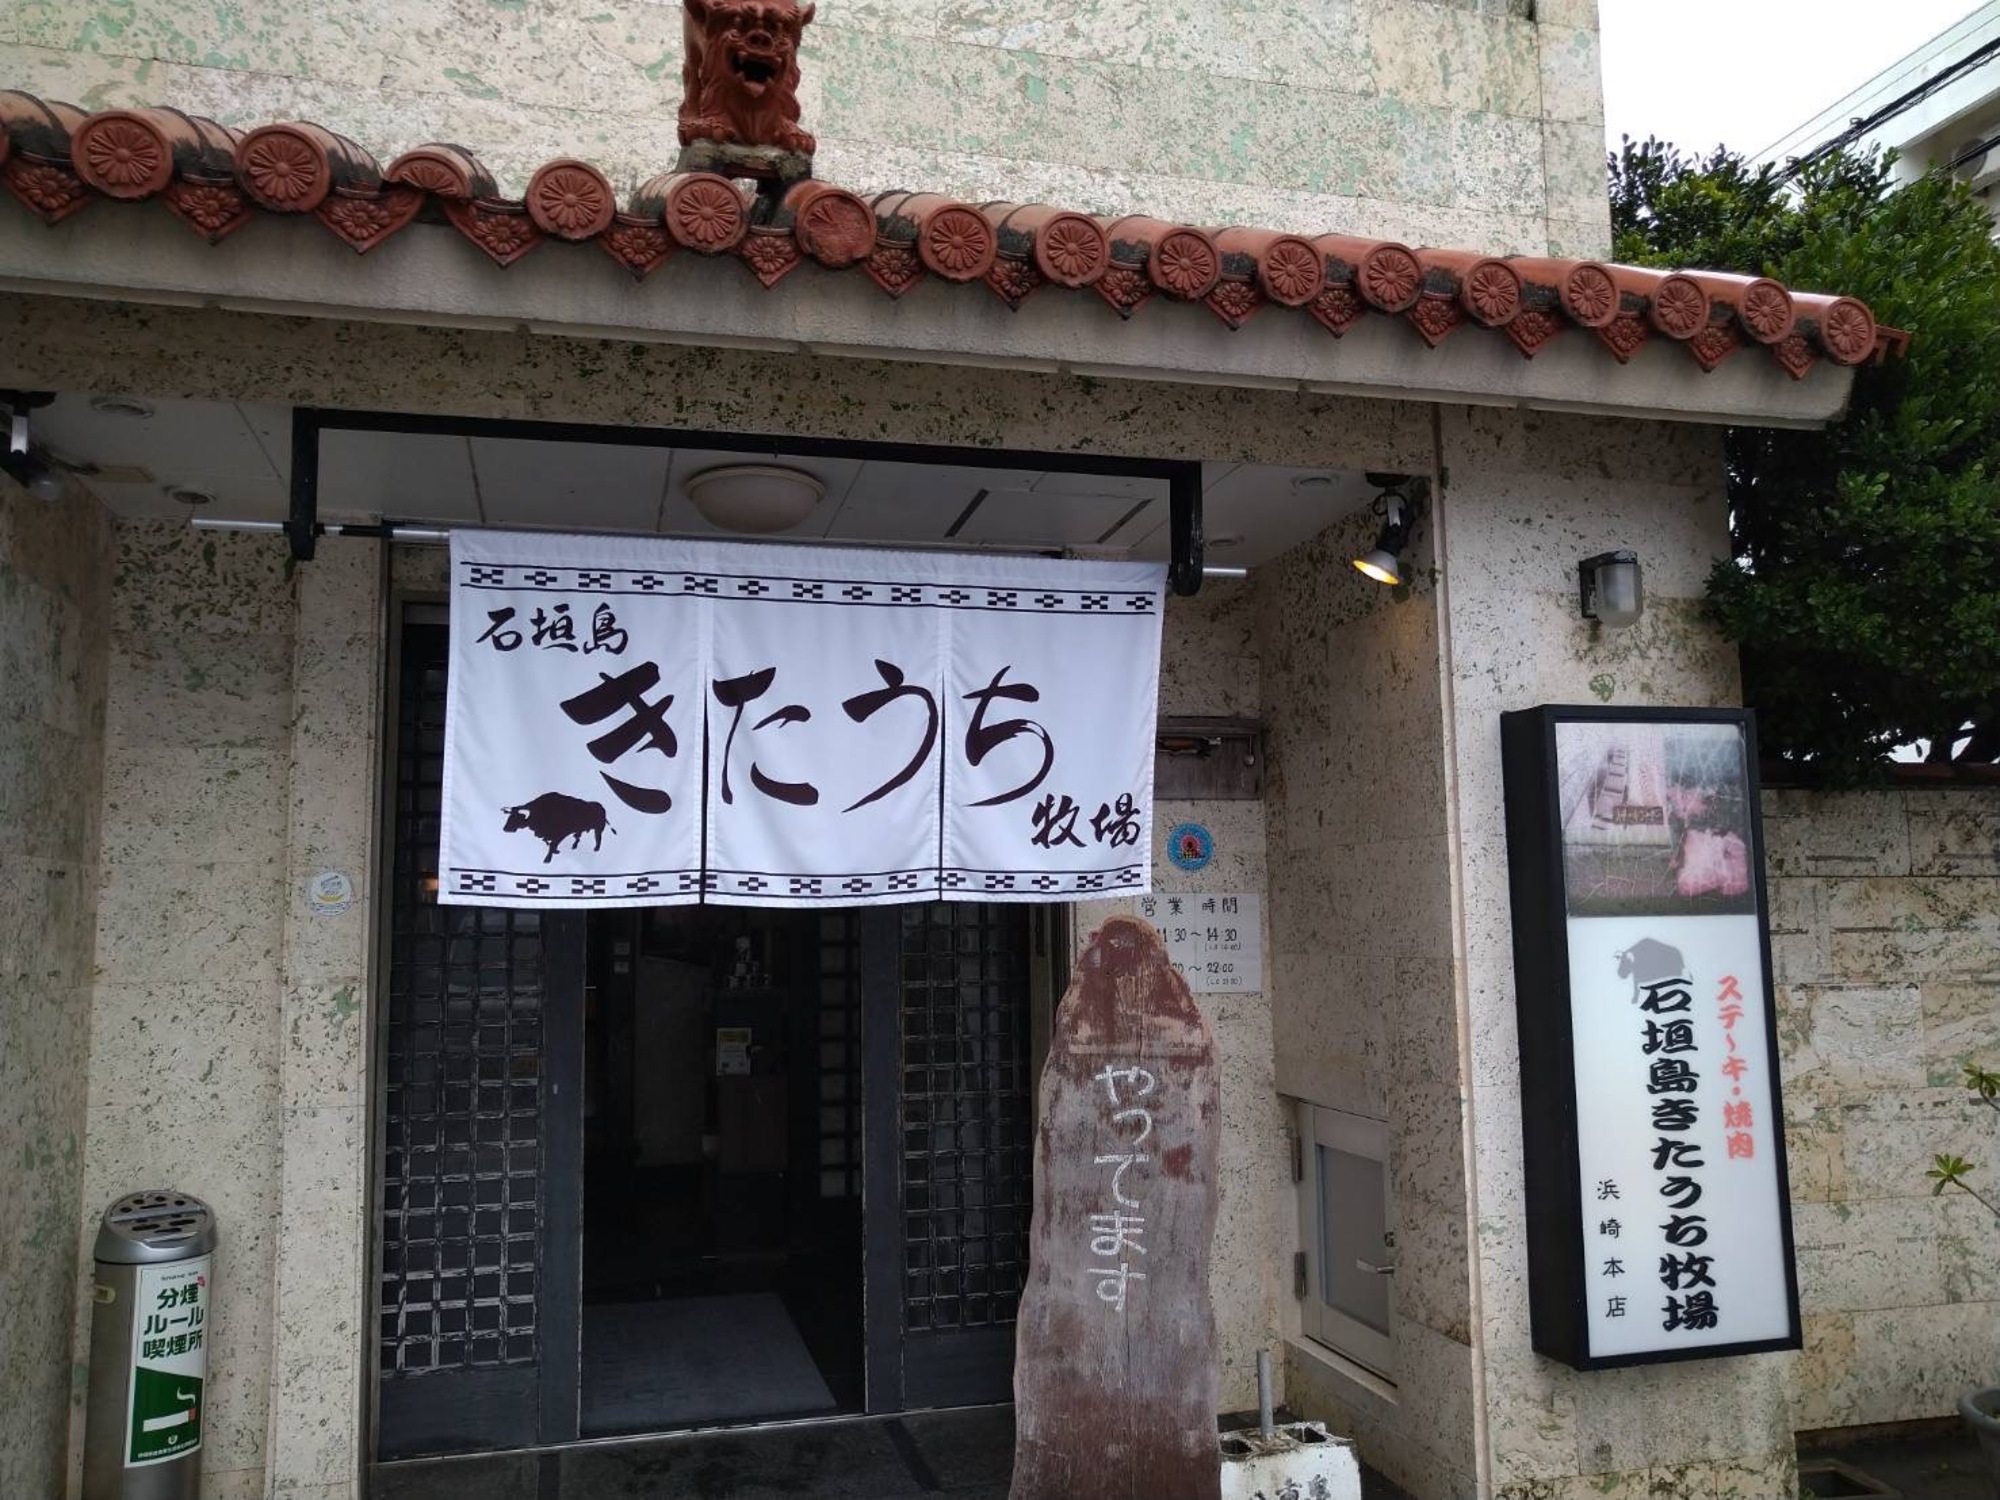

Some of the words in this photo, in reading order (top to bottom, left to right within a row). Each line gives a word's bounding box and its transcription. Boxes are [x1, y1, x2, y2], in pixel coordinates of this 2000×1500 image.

[476, 603, 629, 655] 石垣島
[560, 660, 1055, 814] きたうち
[1031, 793, 1141, 850] 牧場
[1141, 897, 1238, 917] 営業時間
[1639, 978, 1719, 1333] 石垣島きたうち牧場
[157, 1283, 199, 1310] 分煙
[144, 1306, 204, 1335] ルール
[142, 1329, 203, 1359] 喫煙所
